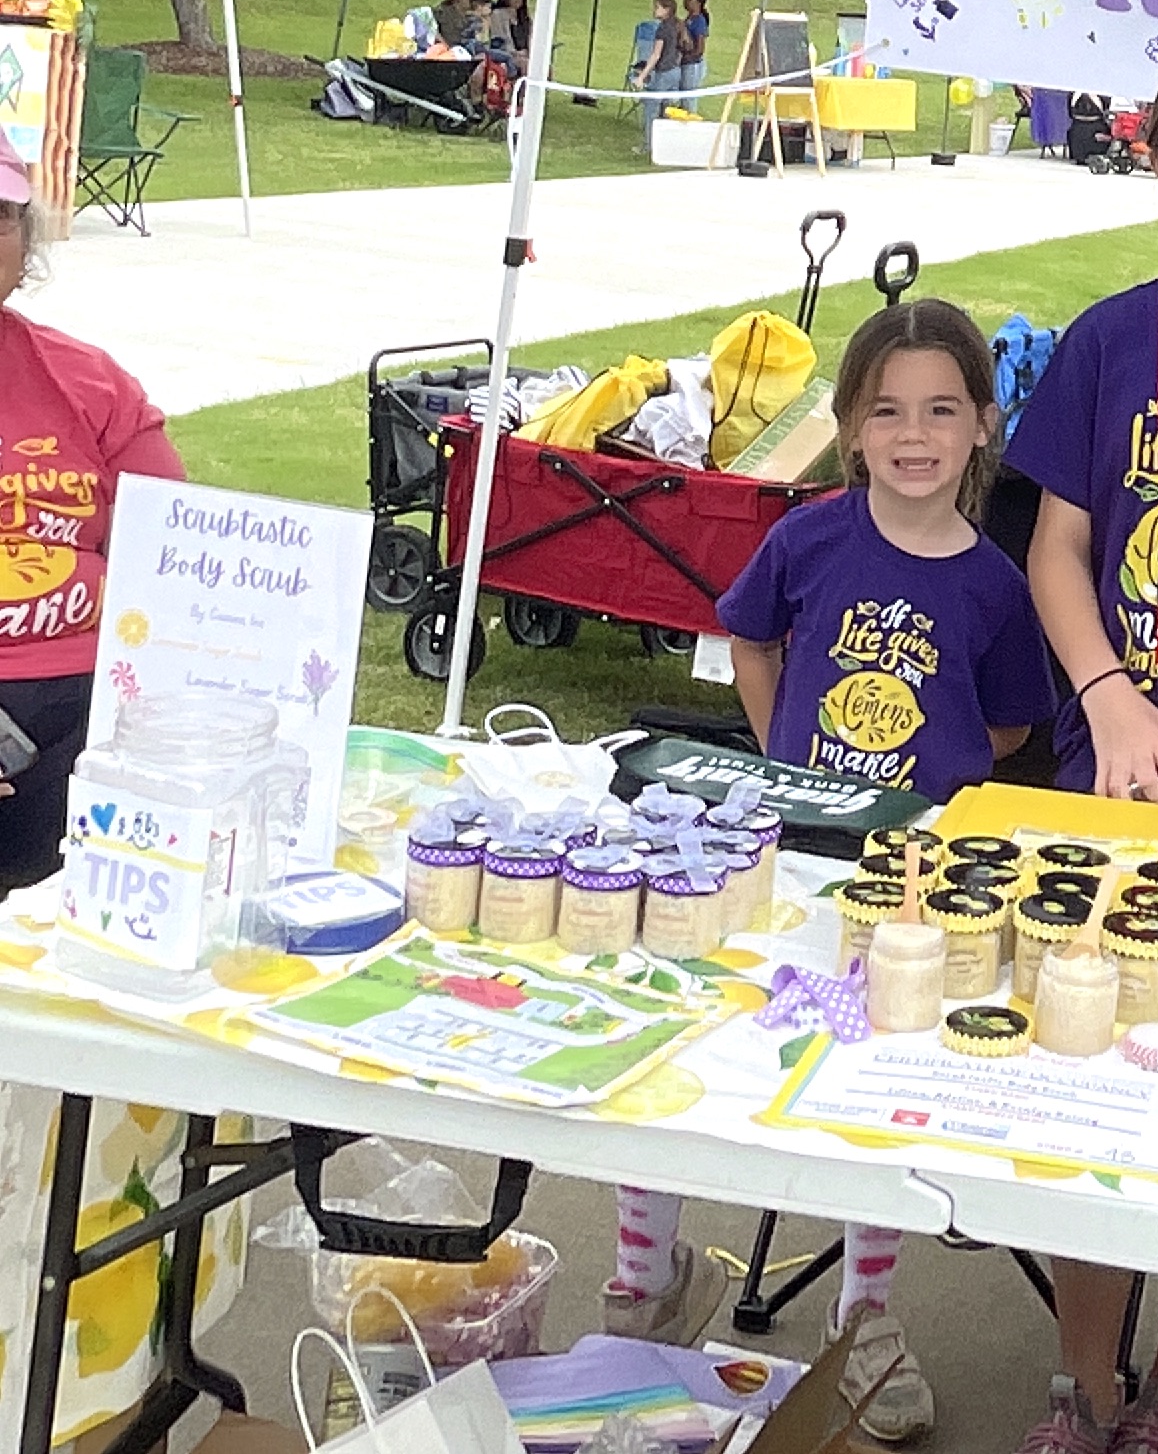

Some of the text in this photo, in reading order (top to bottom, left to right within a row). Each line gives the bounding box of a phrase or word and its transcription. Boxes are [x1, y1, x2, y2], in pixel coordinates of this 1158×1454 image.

[0, 462, 98, 530] gives
[27, 510, 83, 545] you
[165, 498, 313, 549] Scrubtastic
[157, 545, 312, 596] Body Scrub
[0, 581, 94, 638] ake
[881, 598, 911, 629] If
[828, 608, 939, 675] Life gives
[895, 662, 924, 688] you
[831, 680, 914, 734] Lemons
[820, 739, 900, 781] make
[84, 852, 171, 915] TIPS
